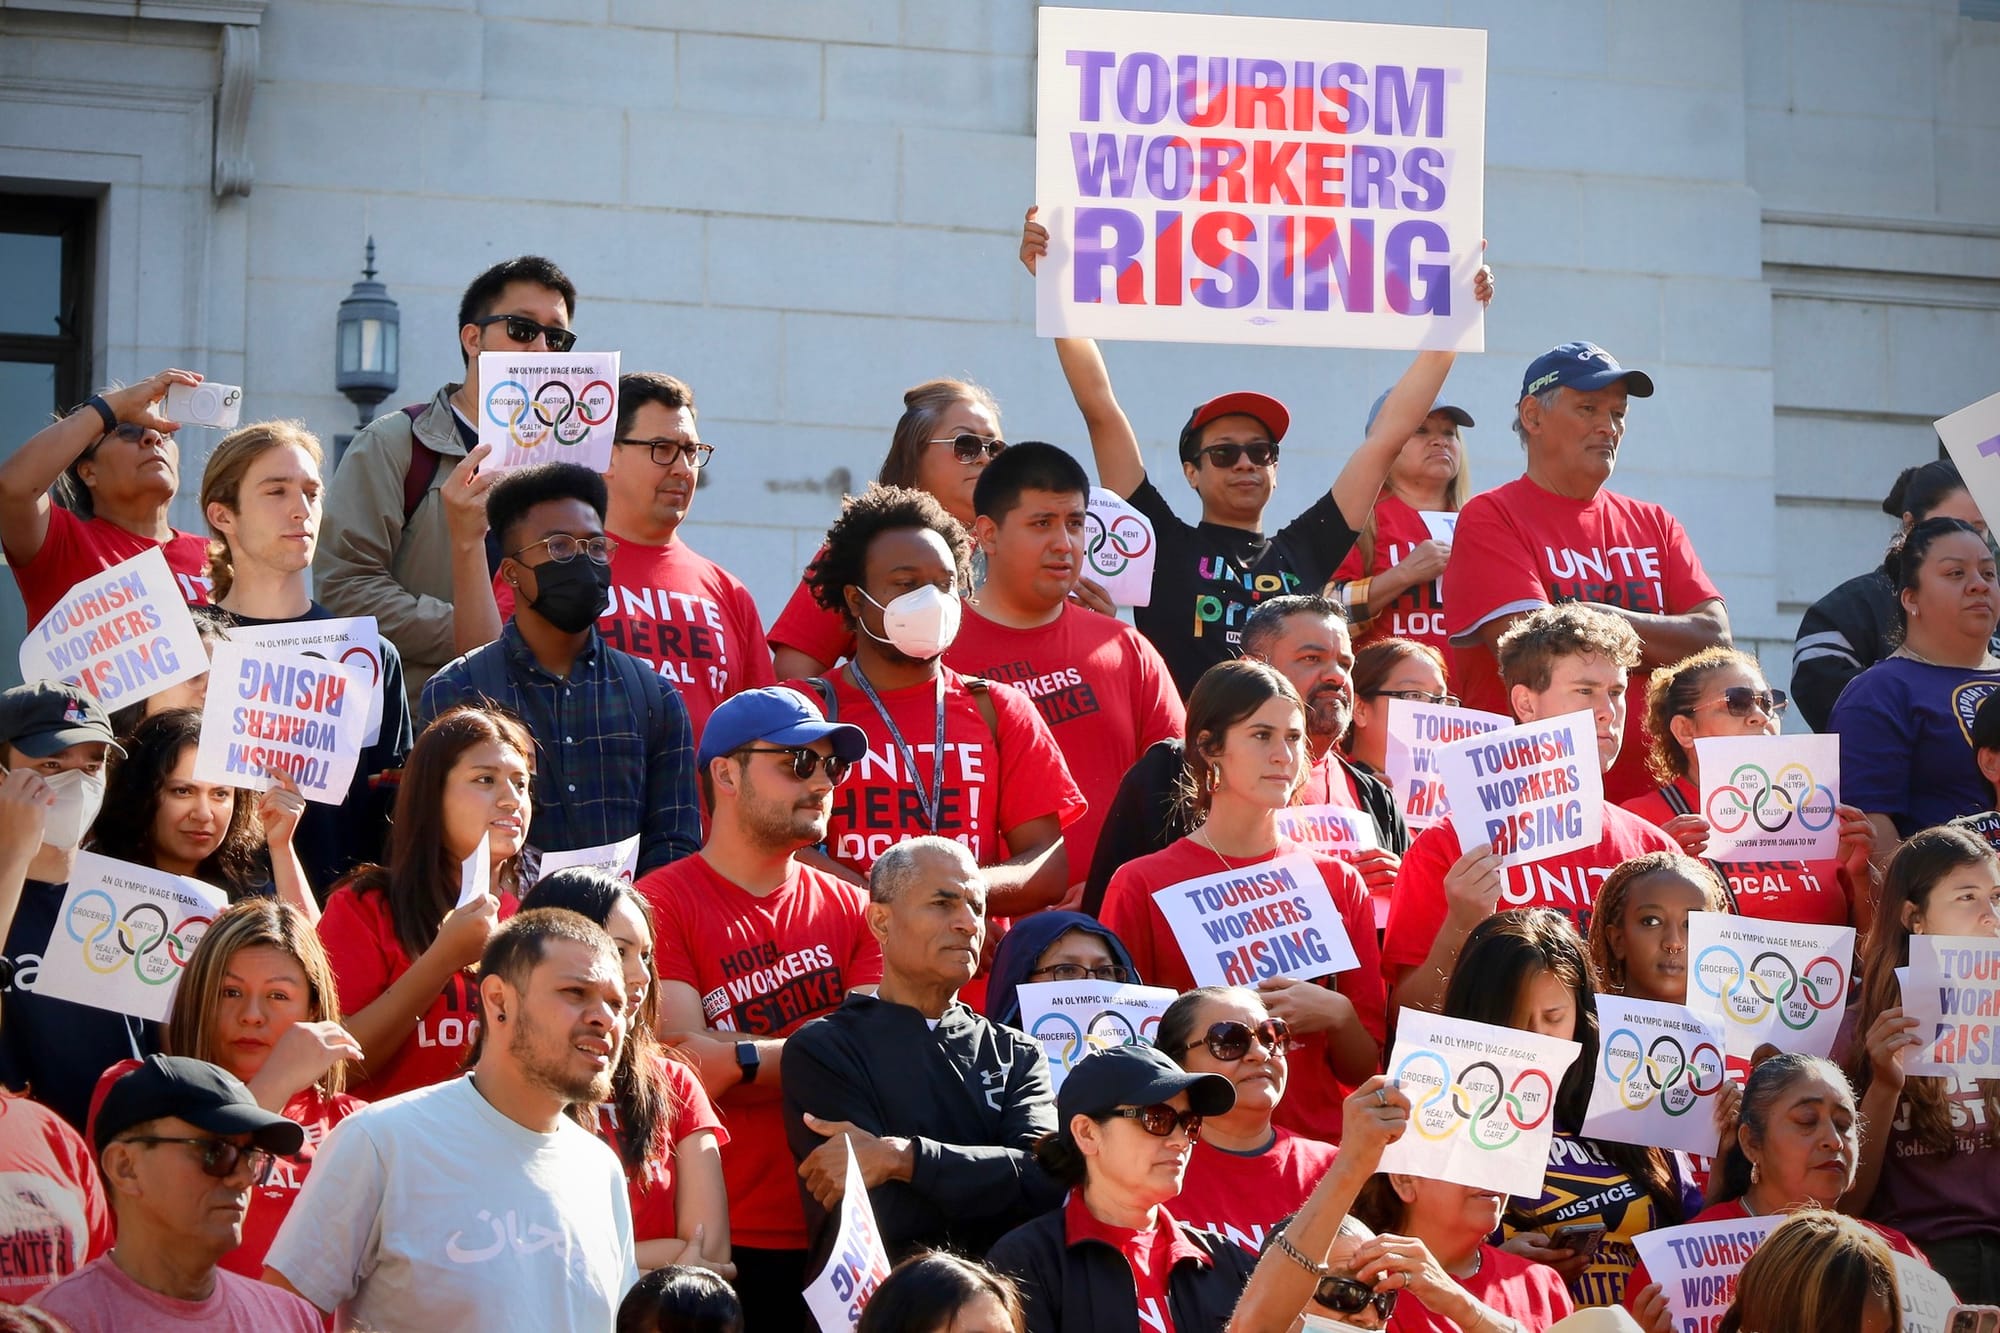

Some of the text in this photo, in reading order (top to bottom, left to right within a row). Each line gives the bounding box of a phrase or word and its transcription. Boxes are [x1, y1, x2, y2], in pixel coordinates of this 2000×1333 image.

[1065, 49, 1446, 138] TOURISM
[1069, 131, 1447, 212] WORKERS
[1073, 206, 1452, 317] RISING
[519, 367, 549, 375] OLYMPIC
[550, 367, 569, 375] WAGE
[1528, 371, 1560, 395] EPIC
[1085, 526, 1098, 534] TICE
[1122, 530, 1138, 538] RENT
[1100, 552, 1118, 560] CHILD
[39, 570, 148, 643] TOURISM
[1393, 612, 1447, 635] LOC
[46, 603, 162, 672] WORKERS
[266, 638, 300, 648] OLYMPIC
[302, 635, 322, 645] WAGE
[238, 658, 347, 717] RISING
[1012, 667, 1082, 698] RKERS
[1041, 686, 1094, 725] IKE
[1959, 686, 1988, 729] AIRPORT
[232, 706, 336, 752] WORKERS
[1465, 727, 1575, 777] TOURISM
[1788, 773, 1802, 781] CARE
[1476, 764, 1580, 812] WORKERS
[1784, 781, 1805, 789] HEALTH
[1406, 779, 1450, 818] RIS
[1762, 808, 1784, 816] JUSTICE
[1801, 806, 1832, 814] GROCERIES
[1485, 799, 1582, 857] RISING
[837, 833, 914, 861] LOC
[1761, 839, 1778, 847] WAGE
[1783, 838, 1806, 846] OLYMPIC
[101, 874, 113, 884] AN
[114, 877, 147, 894] OLYMPIC
[149, 886, 170, 900] WAGE
[1500, 864, 1614, 905] UNIT
[1728, 873, 1822, 895] OCAL 11
[1184, 867, 1298, 915] TOURISM
[72, 905, 111, 923] GROCERIES
[1202, 896, 1312, 945] WORKERS
[130, 920, 159, 933] JUSTICE
[184, 934, 202, 945] REN
[1719, 930, 1731, 938] AN
[1732, 931, 1765, 944] OLYMPIC
[1766, 937, 1788, 947] WAGE
[94, 943, 121, 957] HEALTH
[95, 953, 114, 964] CARE
[149, 954, 169, 967] CHILD
[719, 940, 785, 979] HOTEL
[1216, 927, 1331, 987] RISING
[146, 963, 165, 975] CARE
[1699, 963, 1739, 975] GROCERIES
[1939, 948, 2000, 981] TOUR
[728, 944, 833, 1003] WORKERS
[1759, 969, 1786, 979] JUSTICE
[1815, 976, 1833, 985] RENT
[1052, 997, 1063, 1005] AN
[1065, 995, 1100, 1005] OLYMPIC
[1102, 995, 1122, 1005] WAGE
[1733, 995, 1760, 1005] HEALTH
[1789, 1001, 1808, 1010] CHILD
[1736, 1004, 1756, 1014] CARE
[1789, 1009, 1806, 1019] CARE
[1623, 1013, 1632, 1022] AN
[1633, 1015, 1662, 1027] OLYMPIC
[1663, 1019, 1680, 1031] WAGE
[418, 1017, 480, 1048] LOC
[1036, 1032, 1076, 1041] GROCERIES
[1099, 1029, 1127, 1037] JUSTICE
[1429, 1033, 1442, 1044] AN
[1444, 1036, 1483, 1052] OLYMPIC
[1485, 1043, 1508, 1057] WAGE
[1934, 1023, 2000, 1066] RISI
[1609, 1047, 1639, 1059] GROCERIES
[1655, 1054, 1678, 1065] JUSTICE
[1700, 1062, 1715, 1073] RENT
[1401, 1070, 1444, 1086] GROCERIES
[1465, 1081, 1495, 1094] JUSTICE
[1628, 1081, 1650, 1091] HEALTH
[1672, 1087, 1688, 1097] CHILD
[1522, 1091, 1541, 1102] RENT
[1629, 1090, 1646, 1099] CARE
[1670, 1096, 1686, 1105] CARE
[1424, 1108, 1454, 1120] HEALTH
[1425, 1117, 1446, 1128] CARE
[1486, 1119, 1509, 1131] CHILD
[1483, 1129, 1504, 1140] CARE
[1556, 1183, 1637, 1221] JUSTICE
[0, 1241, 66, 1276] ENTER
[1681, 1273, 1738, 1308] WORK
